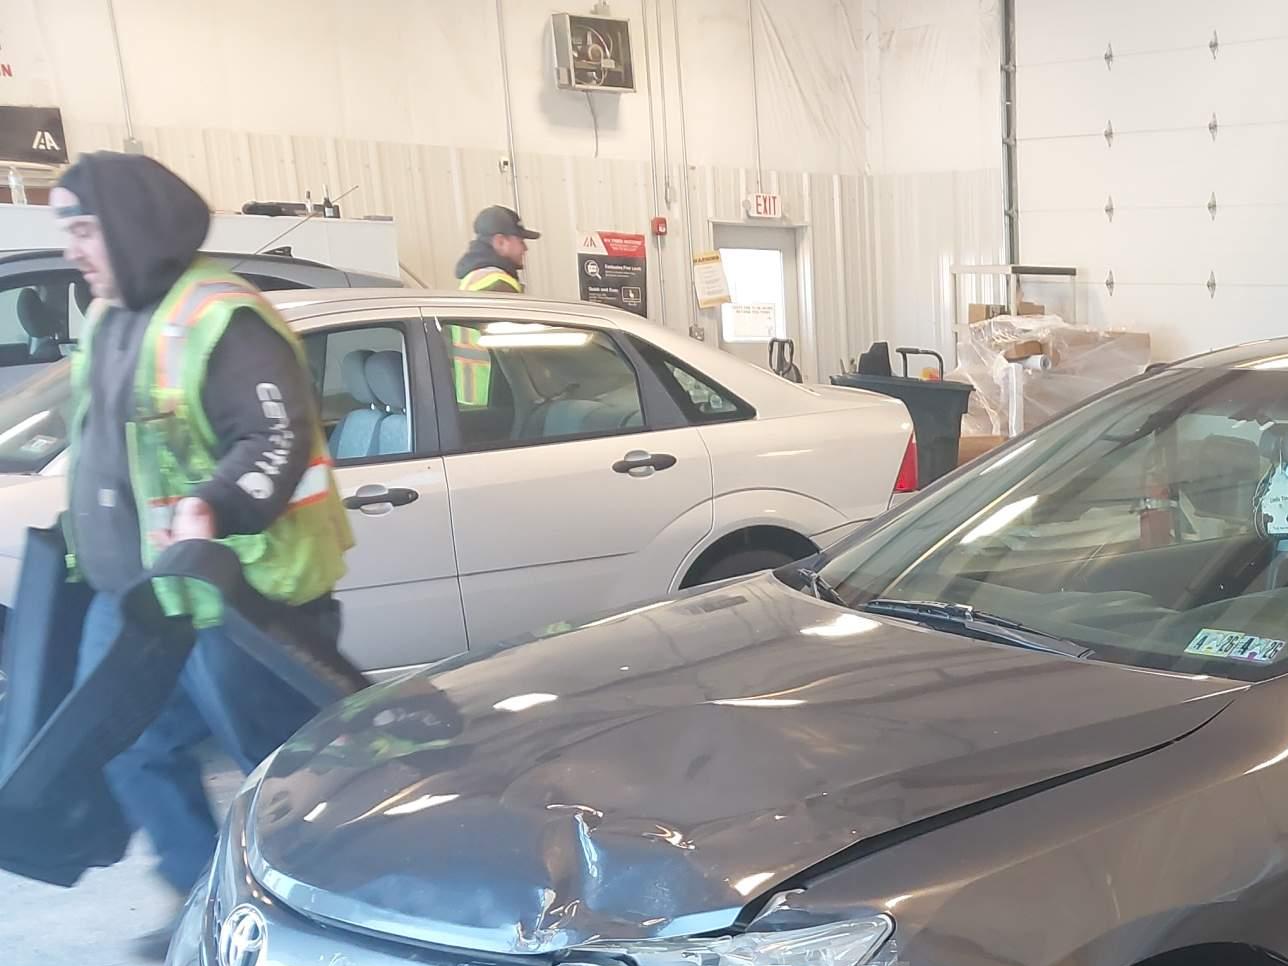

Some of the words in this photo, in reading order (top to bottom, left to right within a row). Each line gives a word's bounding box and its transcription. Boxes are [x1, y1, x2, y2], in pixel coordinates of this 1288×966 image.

[755, 195, 777, 216] EXIT
[1240, 637, 1254, 655] 4
[1262, 641, 1283, 659] 26
